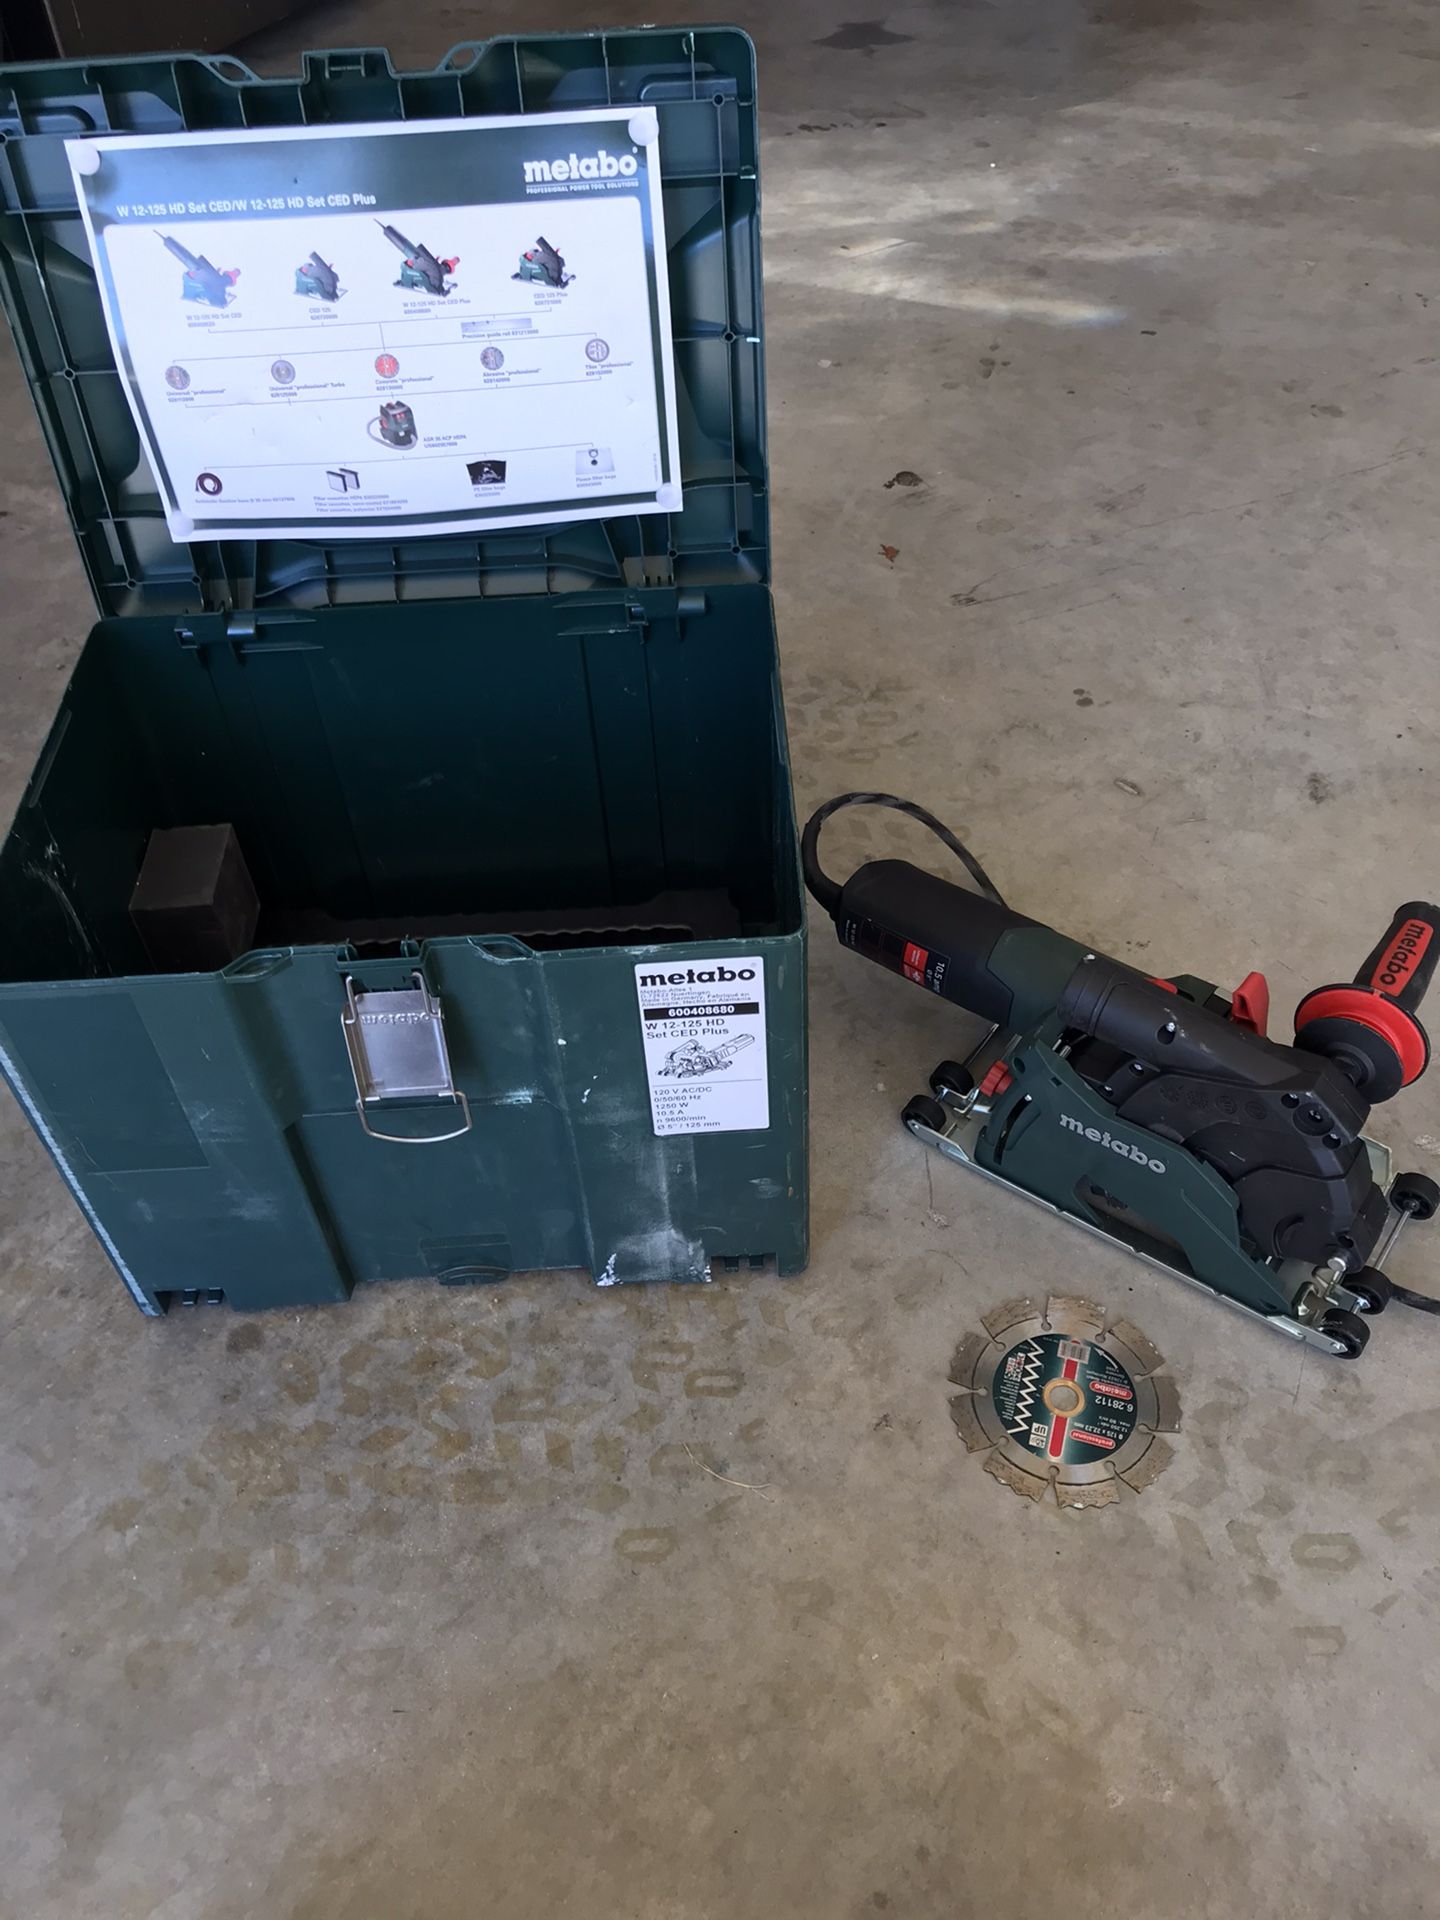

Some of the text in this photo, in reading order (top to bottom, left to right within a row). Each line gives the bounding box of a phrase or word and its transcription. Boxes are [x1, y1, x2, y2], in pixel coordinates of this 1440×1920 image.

[523, 150, 638, 183] metabo
[526, 180, 639, 195] PROFESSIONAL POWER TOOL SOLUTIONS
[117, 193, 376, 217] W 12-125 HD Set CED/W 12-125 HD Set CED Plus
[1379, 922, 1426, 986] metabo
[640, 966, 755, 987] metabo
[668, 1005, 735, 1017] 600408680
[361, 1012, 431, 1025] metabo
[662, 1020, 702, 1029] 12-125
[646, 1028, 729, 1039] Set CED Plus
[681, 1086, 712, 1094] AC/DC
[1059, 1113, 1167, 1175] metabo
[1095, 1383, 1127, 1396] metabo
[1095, 1395, 1134, 1412] 6.28112
[1034, 1425, 1046, 1434] UP
[1107, 1431, 1117, 1439] 125
[1073, 1432, 1113, 1447] professional
